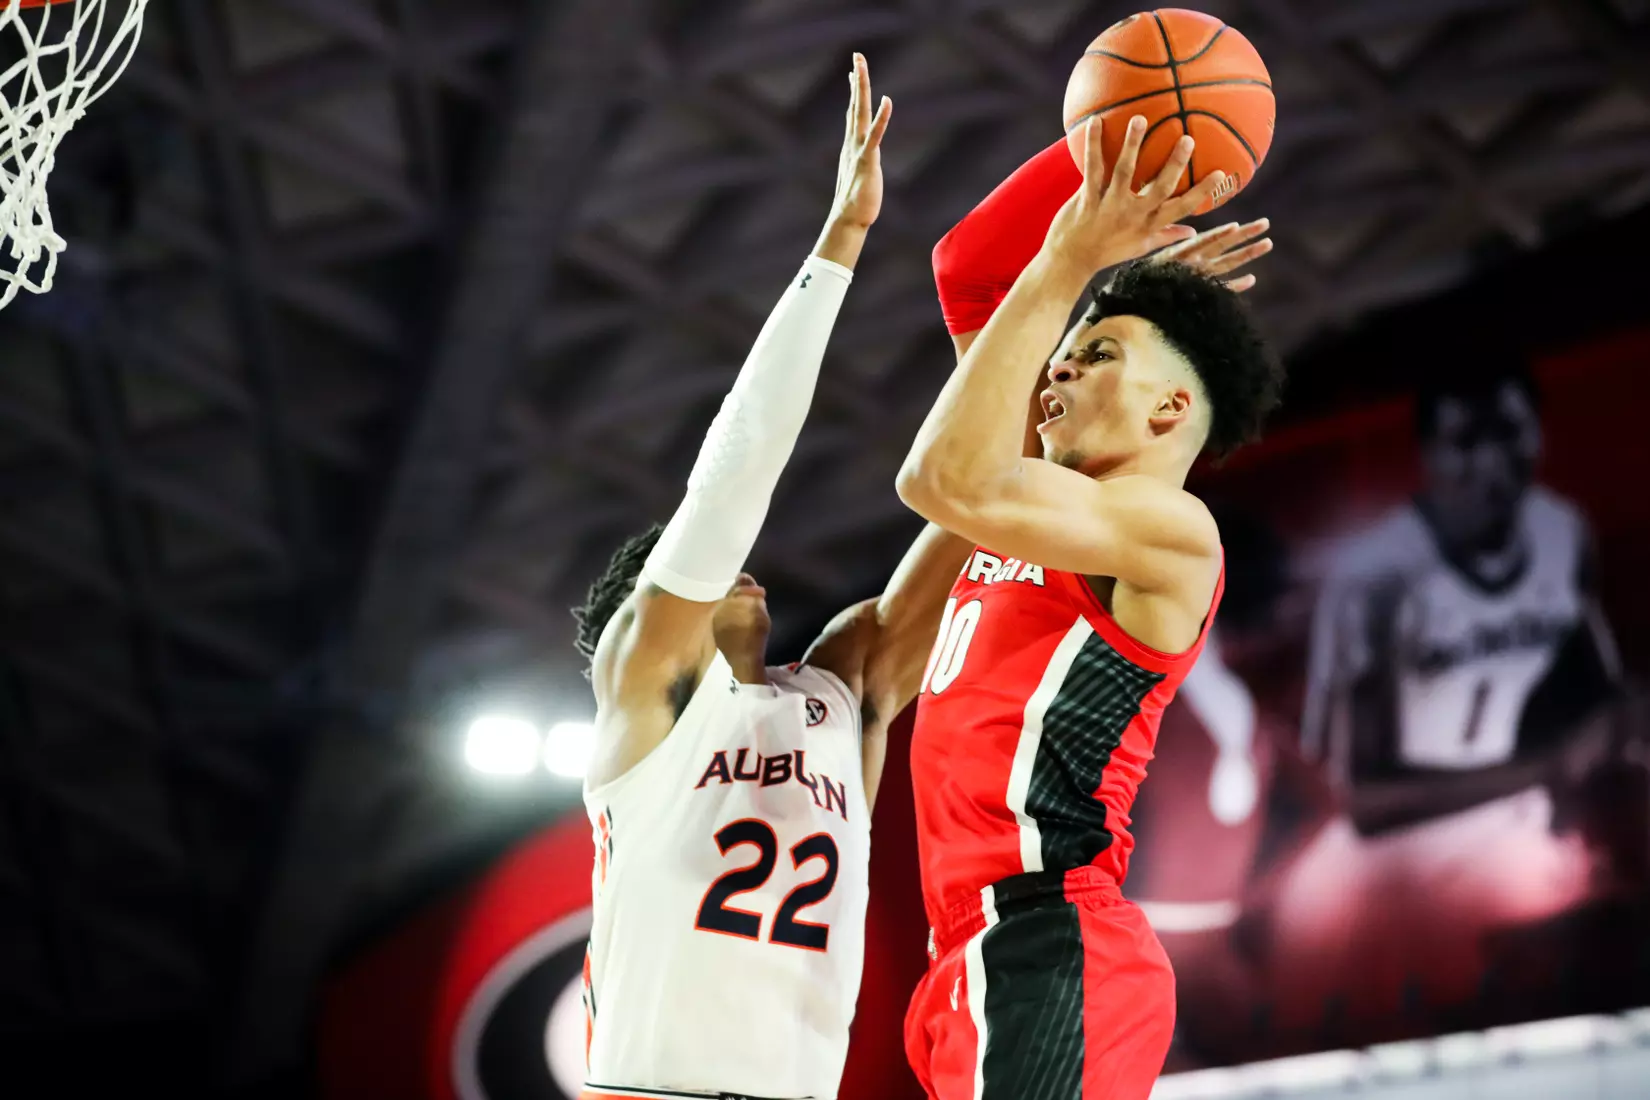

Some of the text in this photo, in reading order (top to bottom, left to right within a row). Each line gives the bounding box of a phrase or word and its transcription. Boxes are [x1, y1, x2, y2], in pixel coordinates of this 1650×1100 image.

[960, 550, 1045, 587] RGIA
[919, 596, 983, 696] 10
[693, 817, 840, 953] 22
